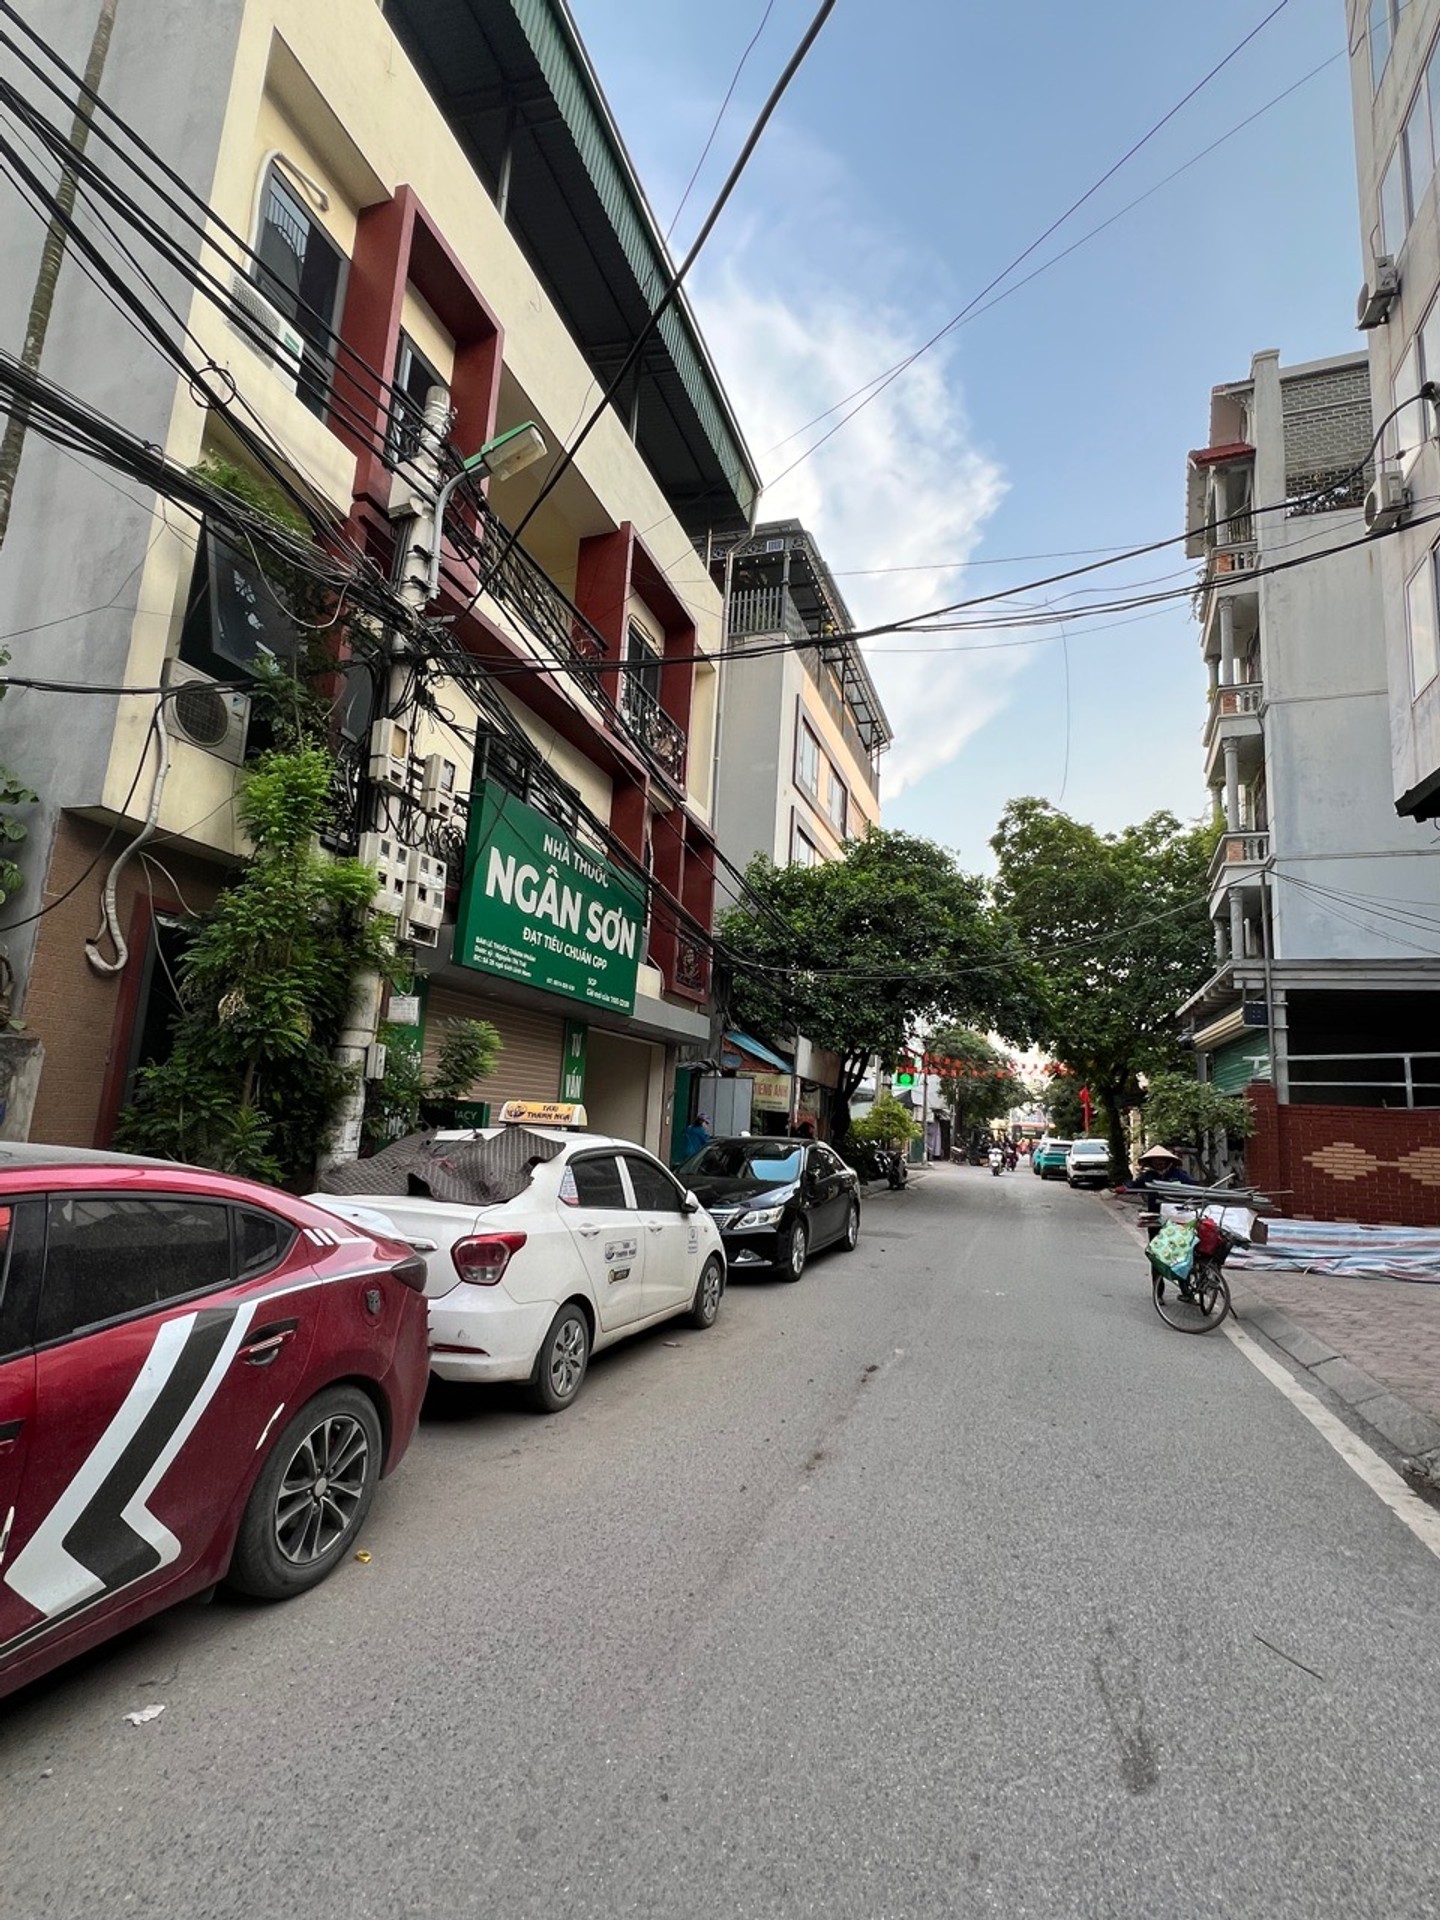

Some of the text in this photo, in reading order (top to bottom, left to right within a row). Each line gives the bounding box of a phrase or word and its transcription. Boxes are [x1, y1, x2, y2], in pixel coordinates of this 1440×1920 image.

[543, 834, 609, 888] NHÀ THUỐC
[485, 846, 636, 959] NGÂN SƠN
[523, 926, 543, 946] ĐẠT
[544, 935, 564, 953] TIÊU
[592, 955, 608, 970] GPP
